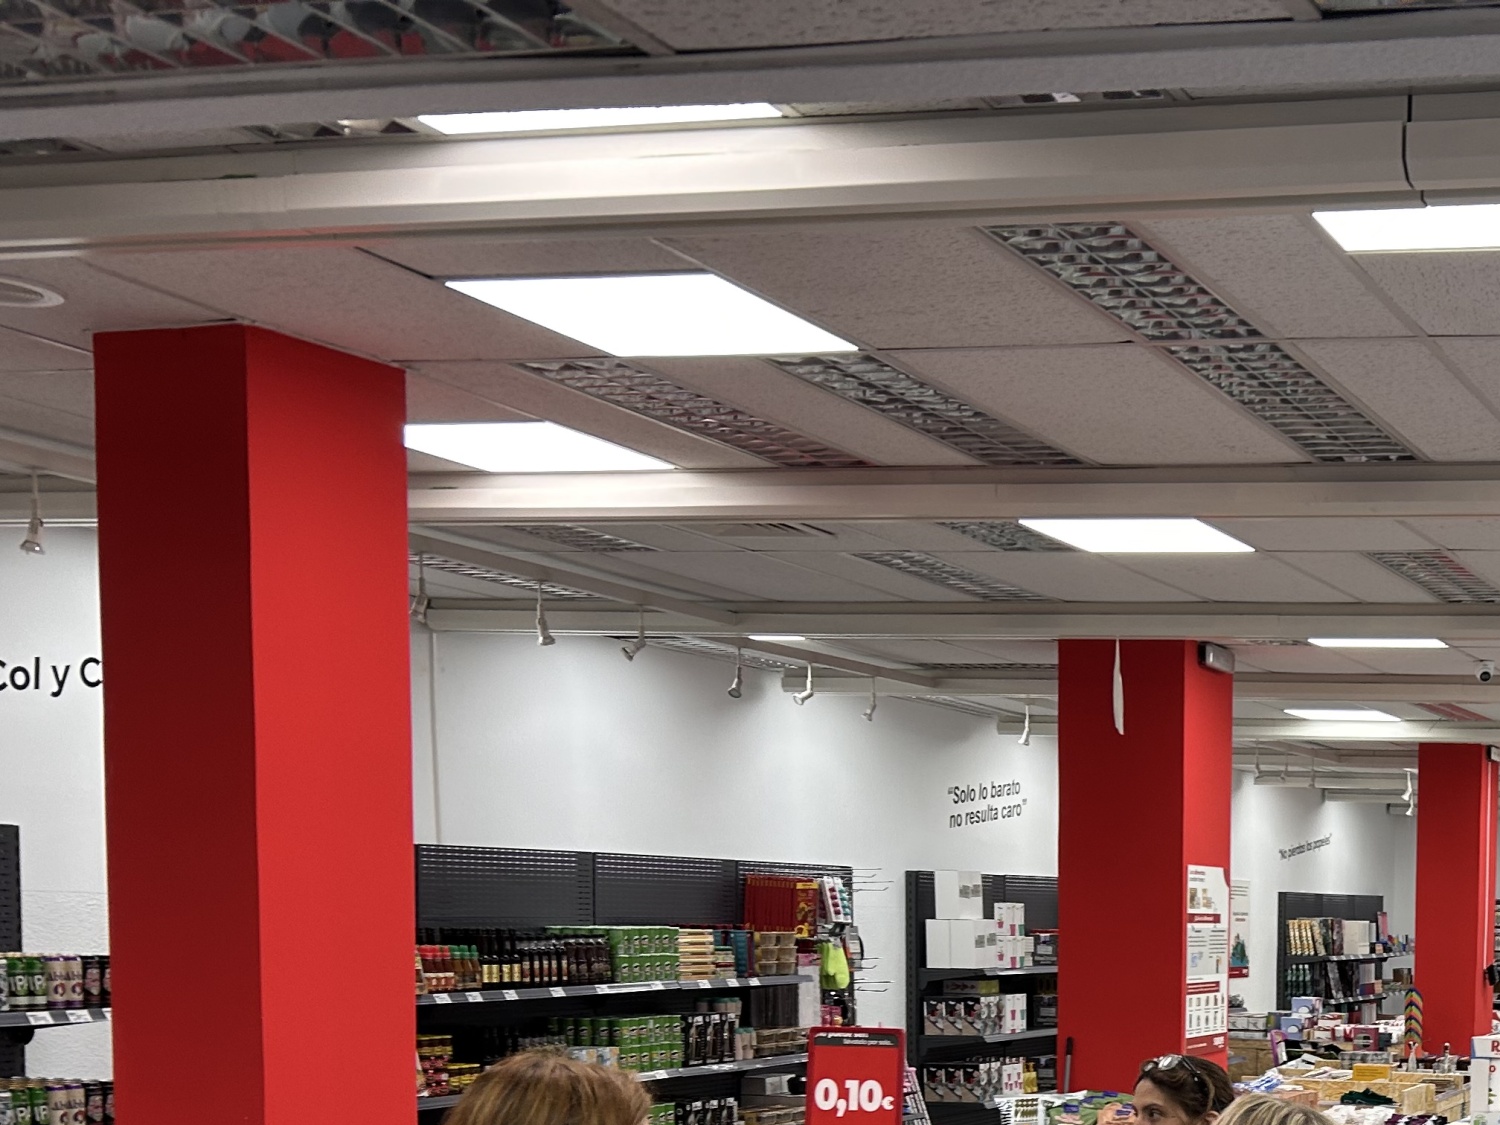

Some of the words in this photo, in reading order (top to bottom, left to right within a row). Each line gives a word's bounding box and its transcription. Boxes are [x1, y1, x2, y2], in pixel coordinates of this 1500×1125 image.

[50, 665, 70, 697] y
[978, 782, 988, 800] lo
[991, 779, 1021, 798] barato
[949, 814, 962, 828] no
[965, 804, 999, 825] resulta
[814, 1078, 894, 1117] 0,10€
